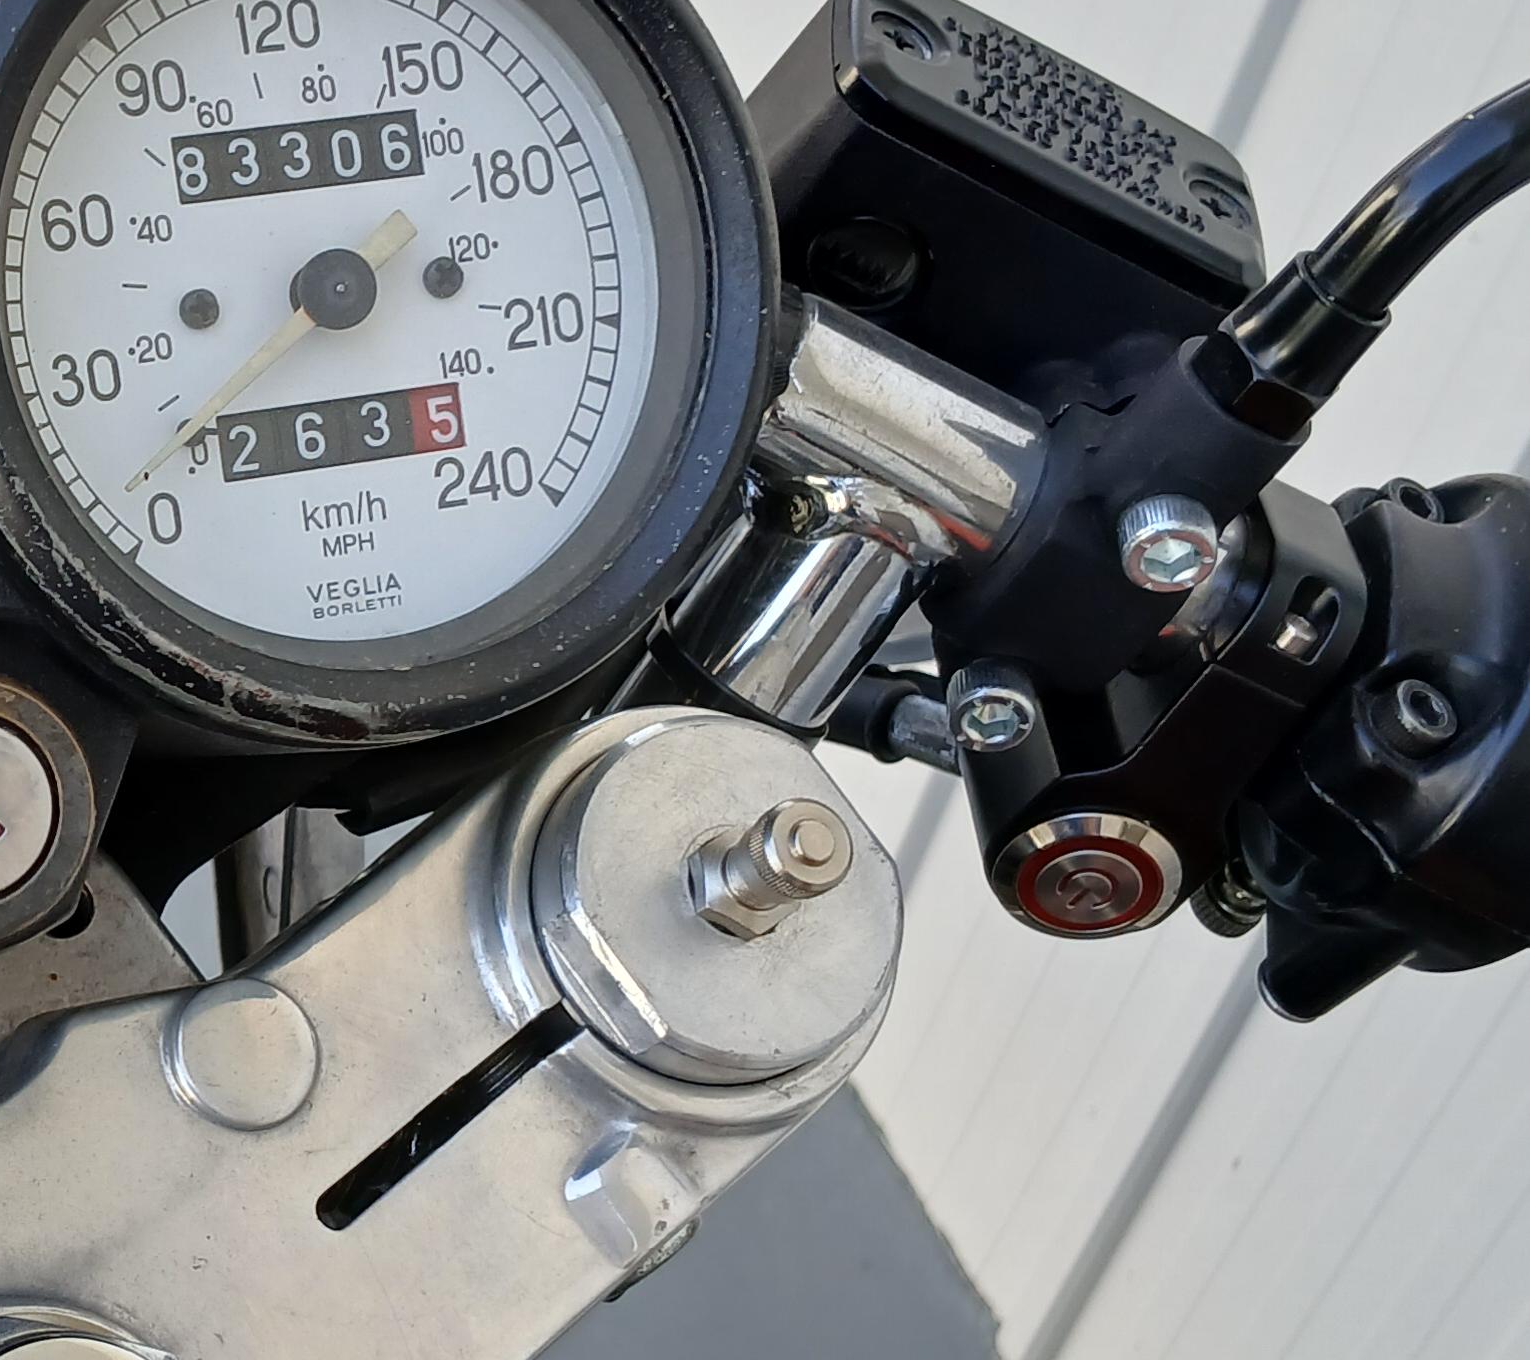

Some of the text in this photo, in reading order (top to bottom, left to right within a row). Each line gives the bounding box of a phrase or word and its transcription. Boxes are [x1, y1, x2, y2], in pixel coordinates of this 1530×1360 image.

[381, 40, 464, 98] 150
[116, 59, 189, 117] 90
[301, 74, 337, 104] 80
[196, 98, 234, 129] 60
[176, 123, 413, 196] 83306
[422, 127, 465, 159] 100
[471, 144, 555, 204] 180
[40, 193, 114, 252] 60
[137, 214, 173, 244] 40
[449, 232, 491, 264] 120
[503, 292, 584, 351] 210
[137, 332, 173, 364] 20
[439, 348, 482, 380] 140
[51, 348, 122, 408] 30
[434, 447, 533, 510] 240
[147, 492, 182, 545] 0
[301, 490, 387, 532] km/h
[322, 531, 375, 558] MPH
[306, 572, 402, 604] VEGLIA
[312, 593, 402, 620] BORLETTI
